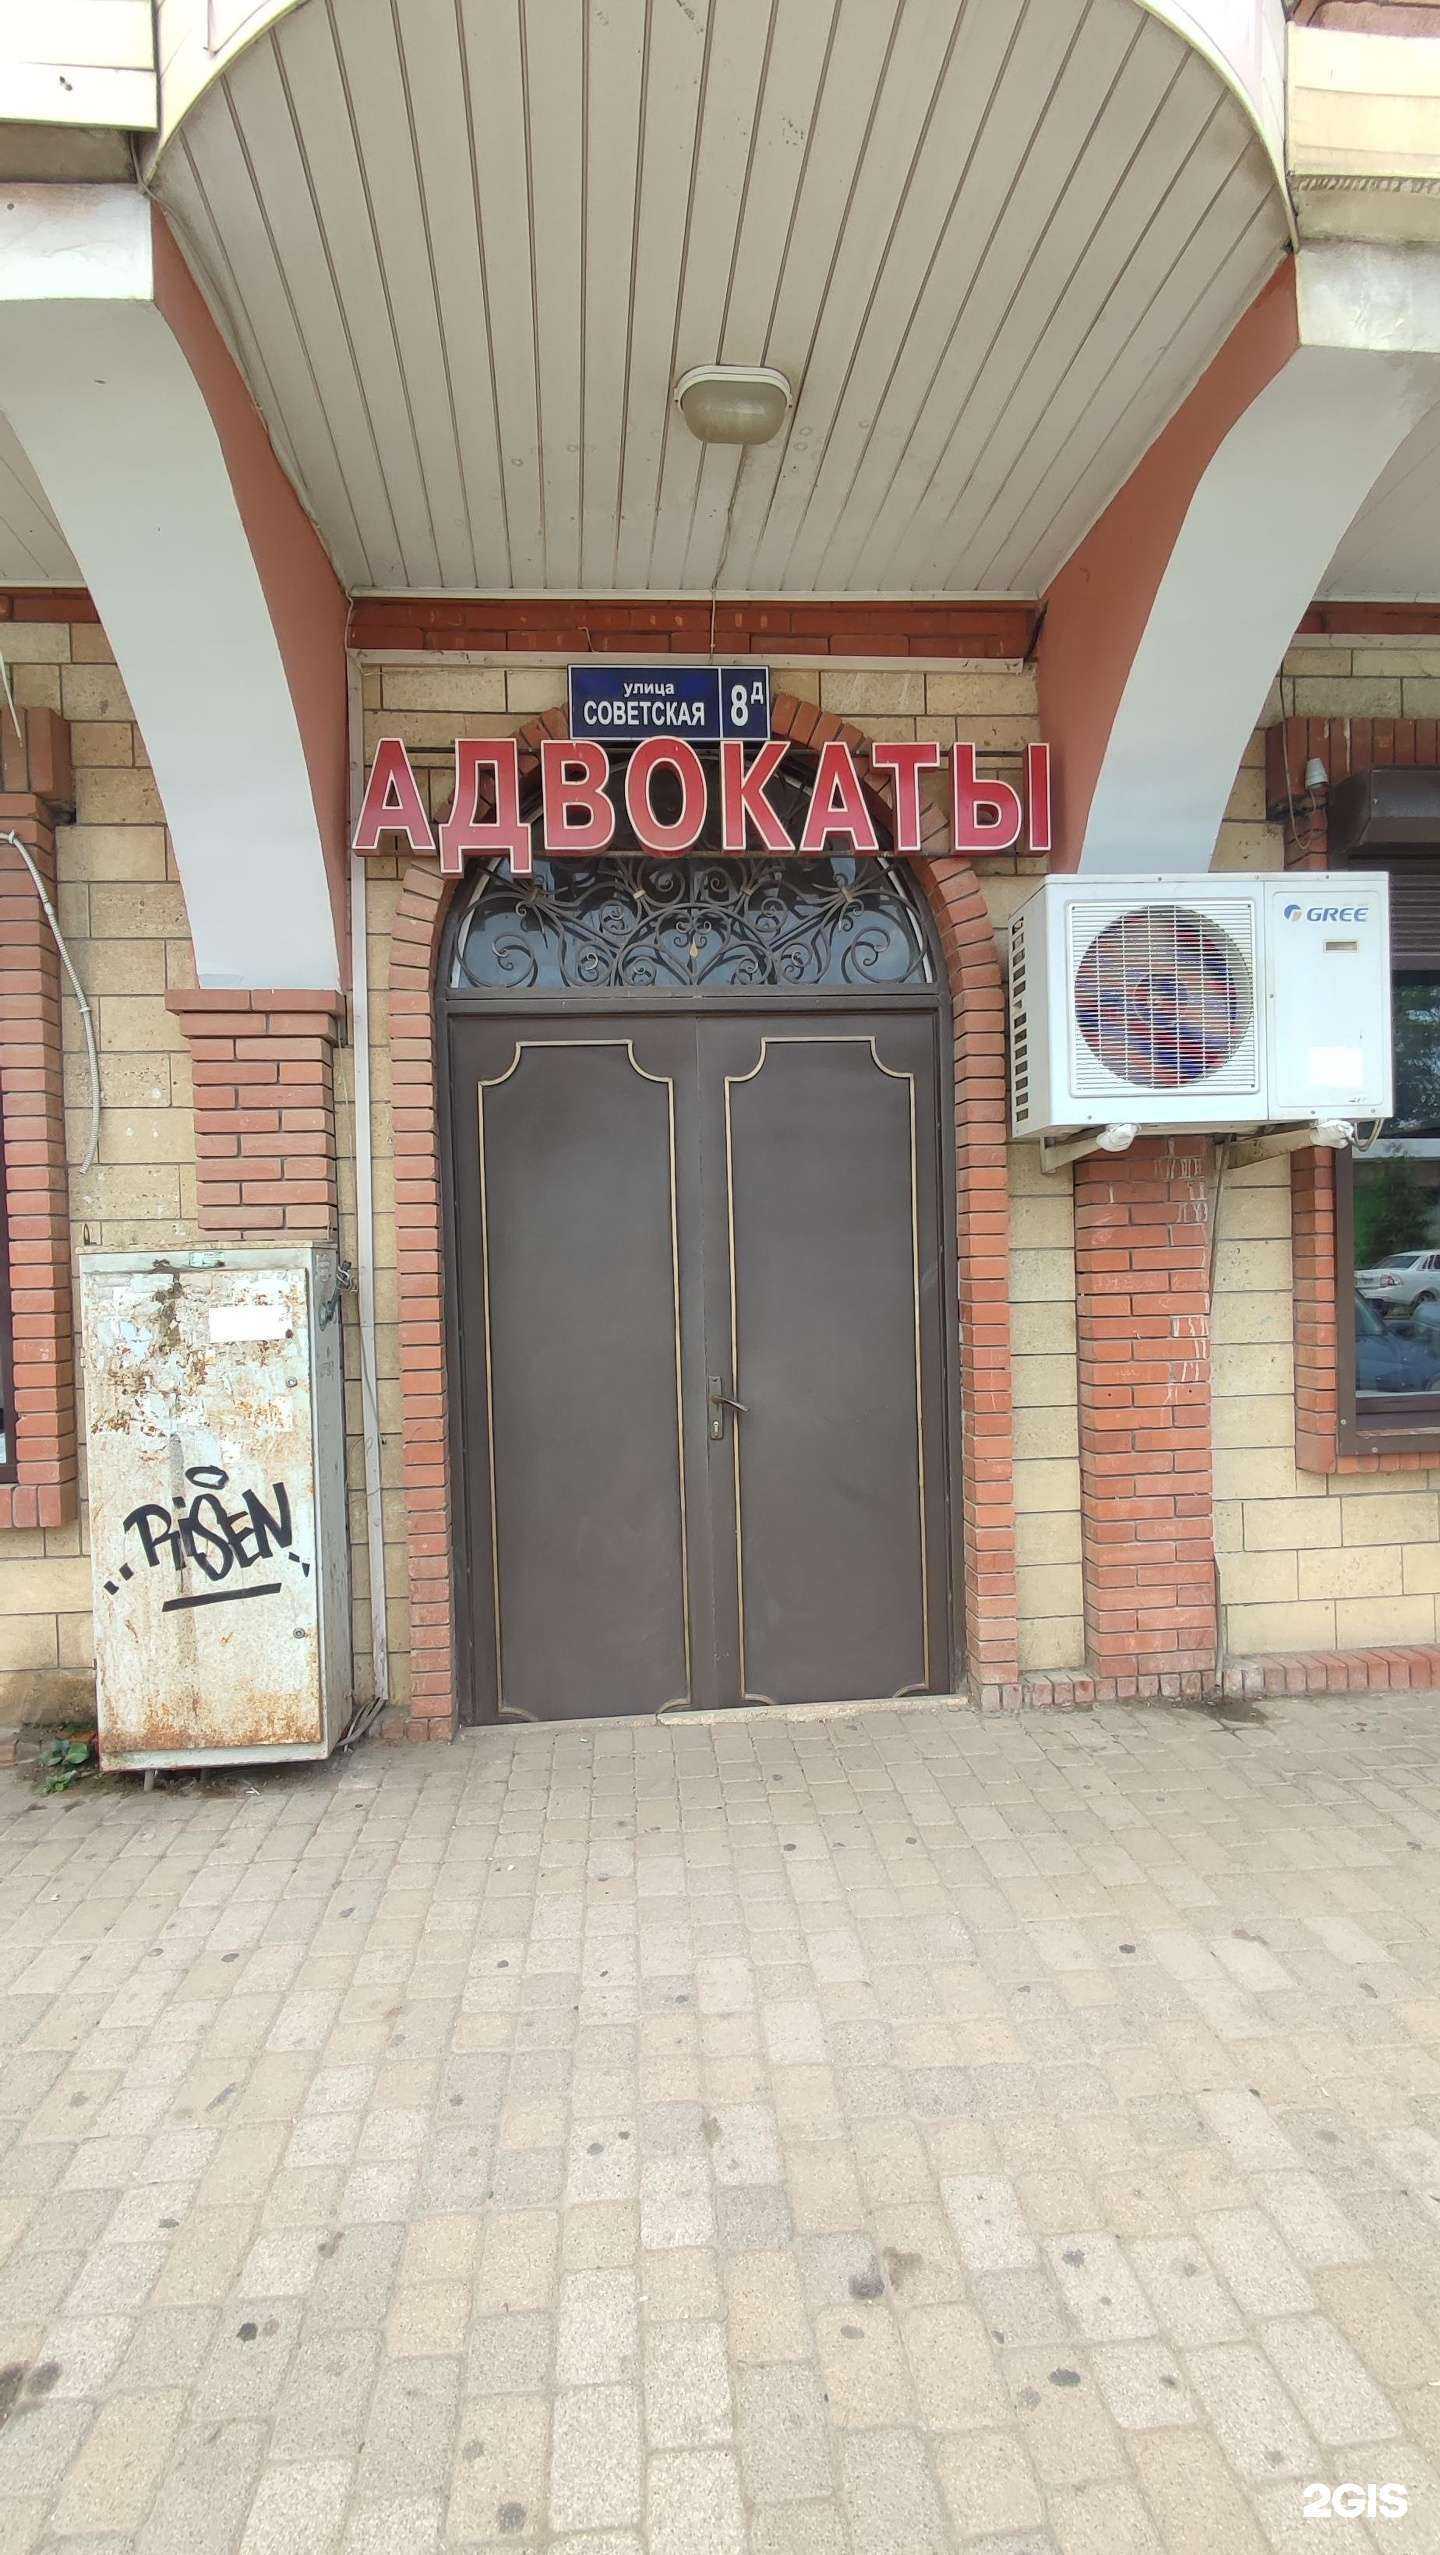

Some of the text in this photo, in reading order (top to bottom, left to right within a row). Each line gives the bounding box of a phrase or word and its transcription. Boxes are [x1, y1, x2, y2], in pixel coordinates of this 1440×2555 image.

[623, 682, 675, 698] улица
[583, 700, 705, 727] СОВЕТСКАЯ
[353, 736, 1052, 875] АДВОКАТЫ
[1306, 907, 1369, 922] GREE
